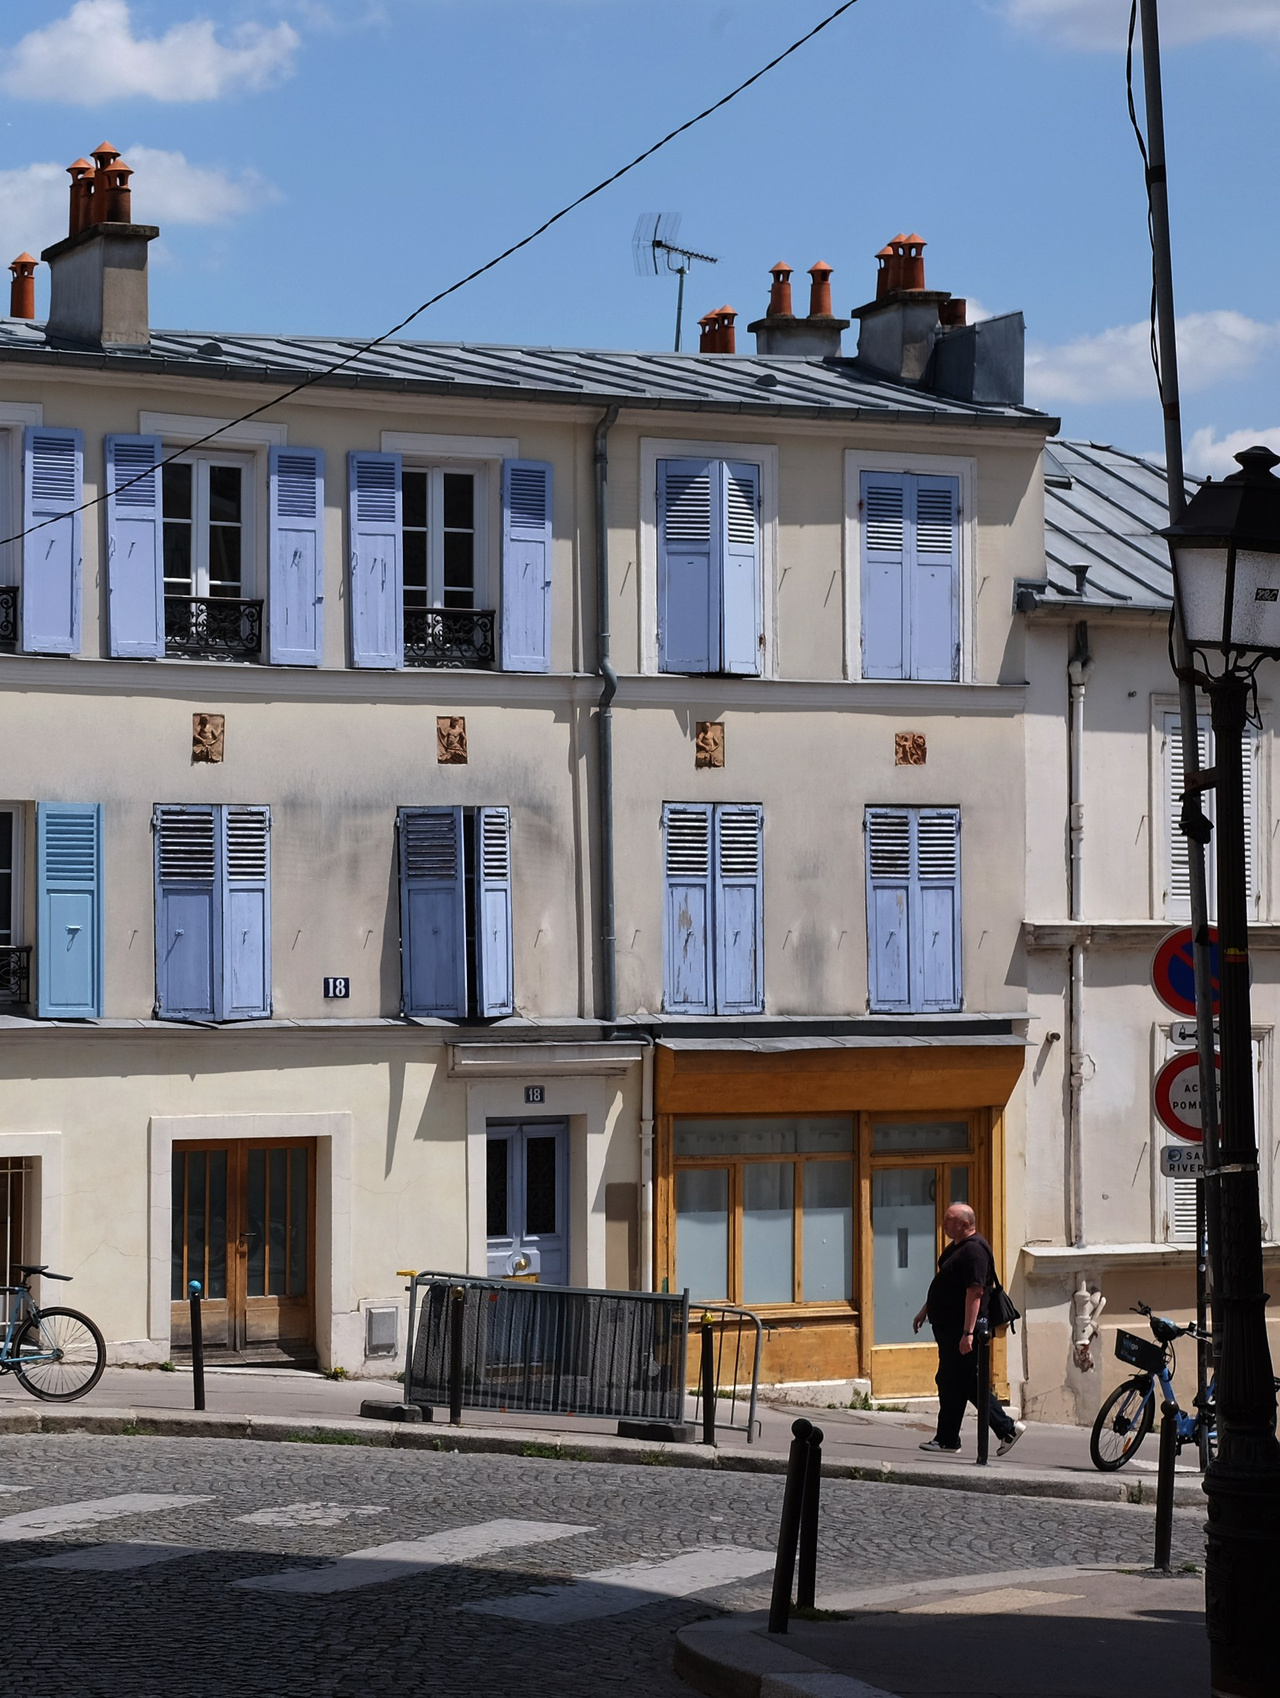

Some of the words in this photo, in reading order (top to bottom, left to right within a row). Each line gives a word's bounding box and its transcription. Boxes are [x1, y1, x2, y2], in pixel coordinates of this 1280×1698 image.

[328, 978, 346, 997] 18
[1184, 1083, 1221, 1093] ACS
[529, 1088, 541, 1101] 18
[1186, 1151, 1202, 1160] SA
[1169, 1163, 1204, 1172] RIVER
